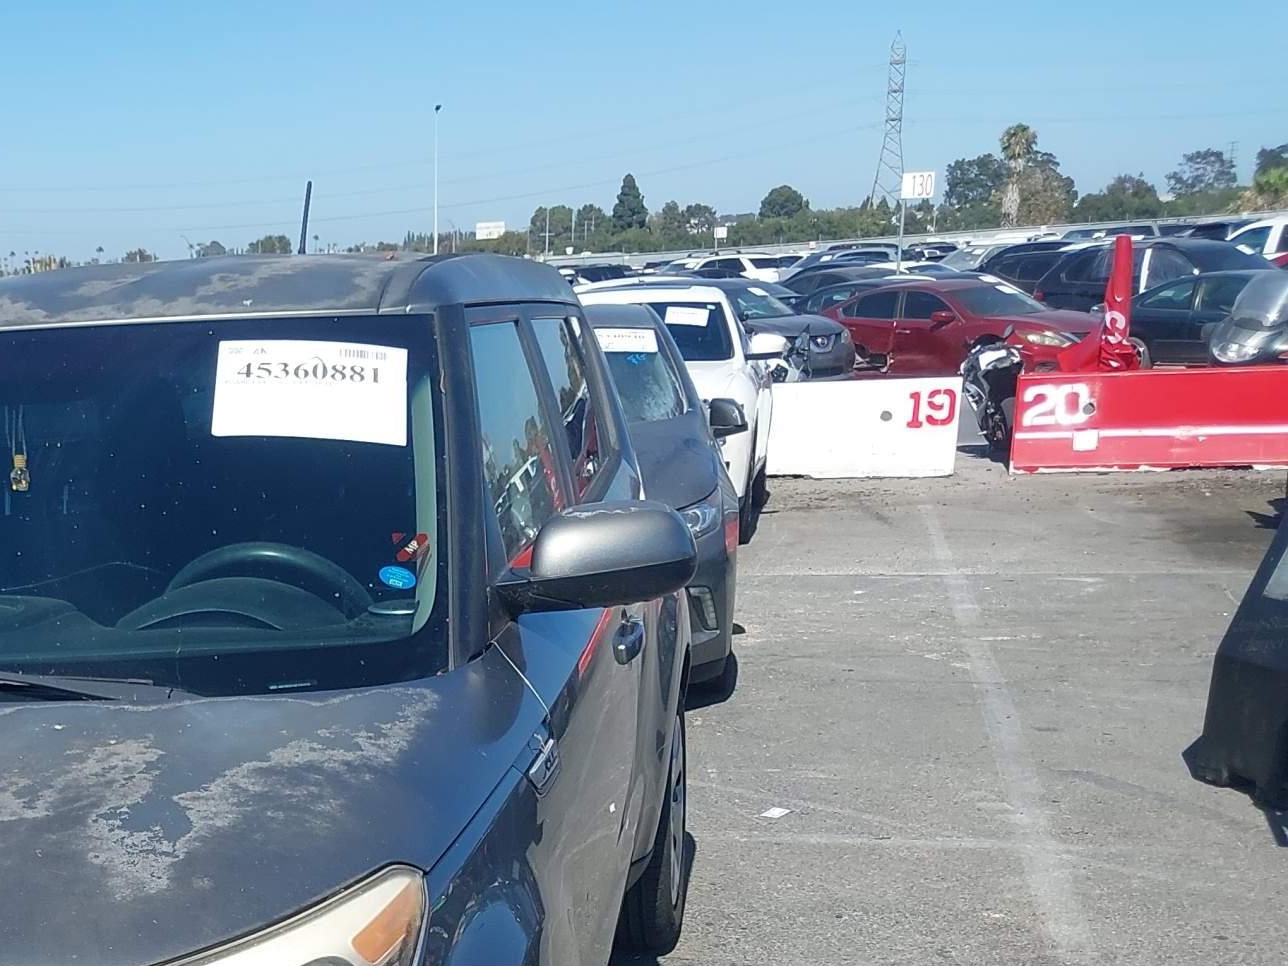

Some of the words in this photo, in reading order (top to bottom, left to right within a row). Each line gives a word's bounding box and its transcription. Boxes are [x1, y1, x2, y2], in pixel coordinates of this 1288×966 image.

[912, 174, 933, 197] 130
[237, 356, 380, 384] 45360881
[906, 389, 957, 429] 19
[1023, 383, 1091, 427] 20
